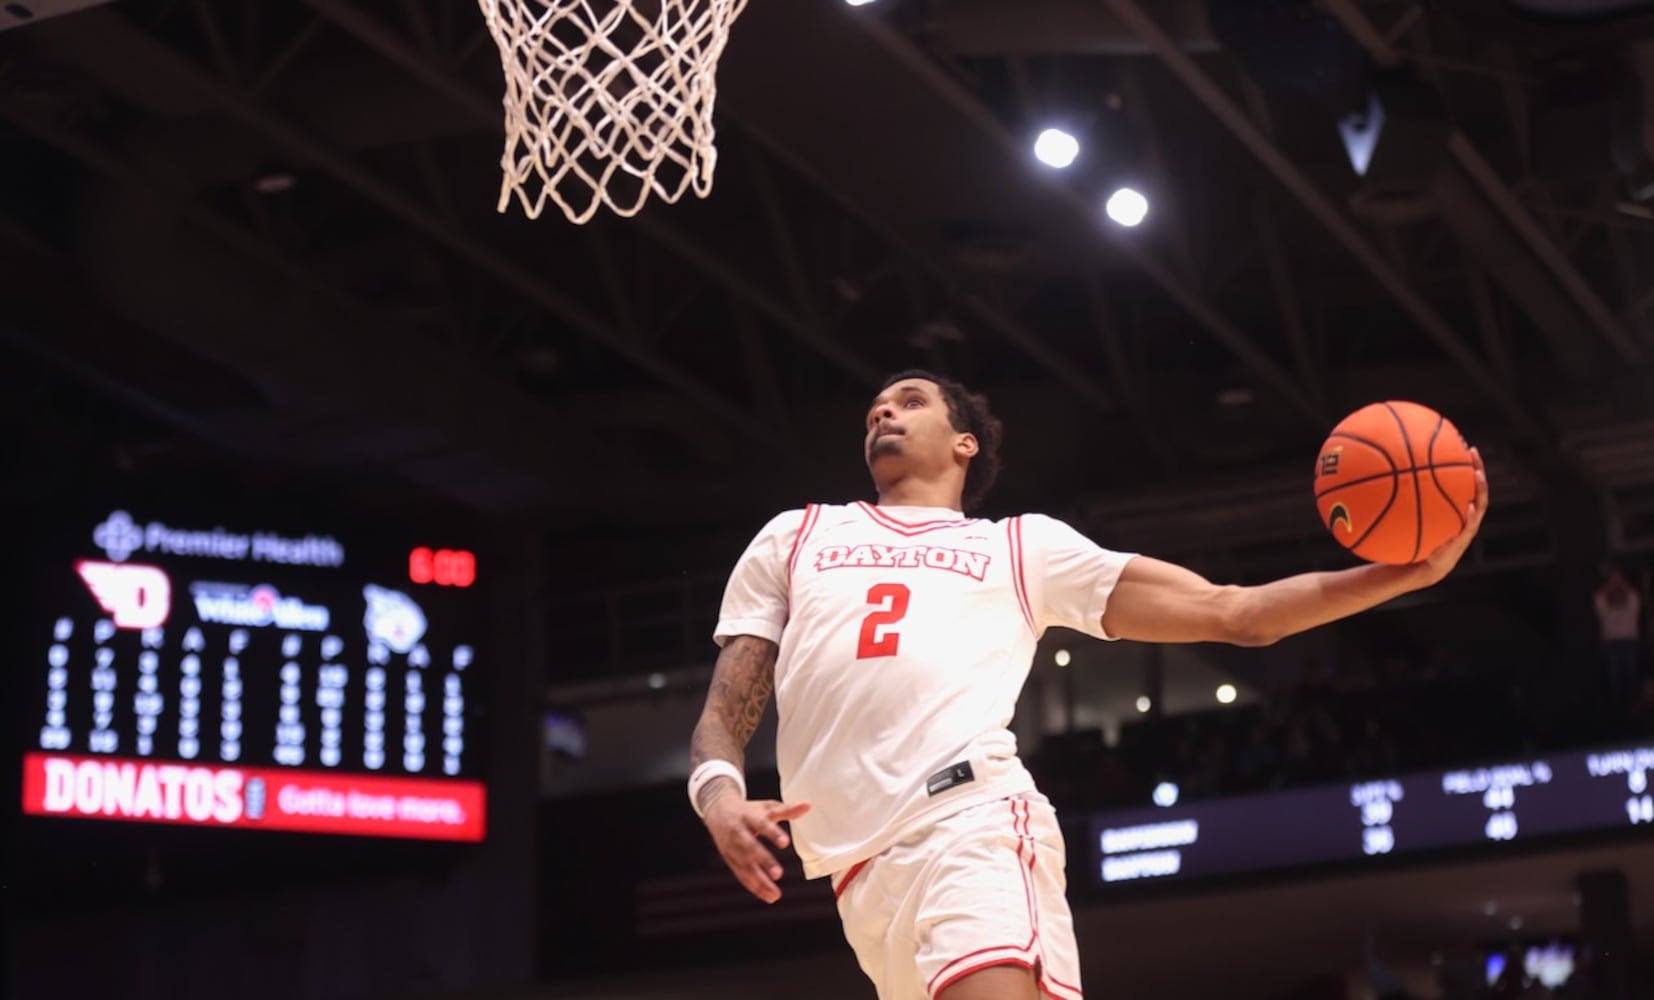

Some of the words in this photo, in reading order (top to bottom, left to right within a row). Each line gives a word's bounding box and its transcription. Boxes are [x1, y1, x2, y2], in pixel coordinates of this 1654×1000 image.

[144, 521, 250, 559] Premier
[252, 530, 344, 567] Health
[813, 544, 991, 582] DAYTON
[857, 583, 911, 660] 2
[43, 758, 244, 823] DONATOS
[956, 768, 966, 778] L
[277, 784, 346, 815] Gotta
[348, 789, 396, 819] love
